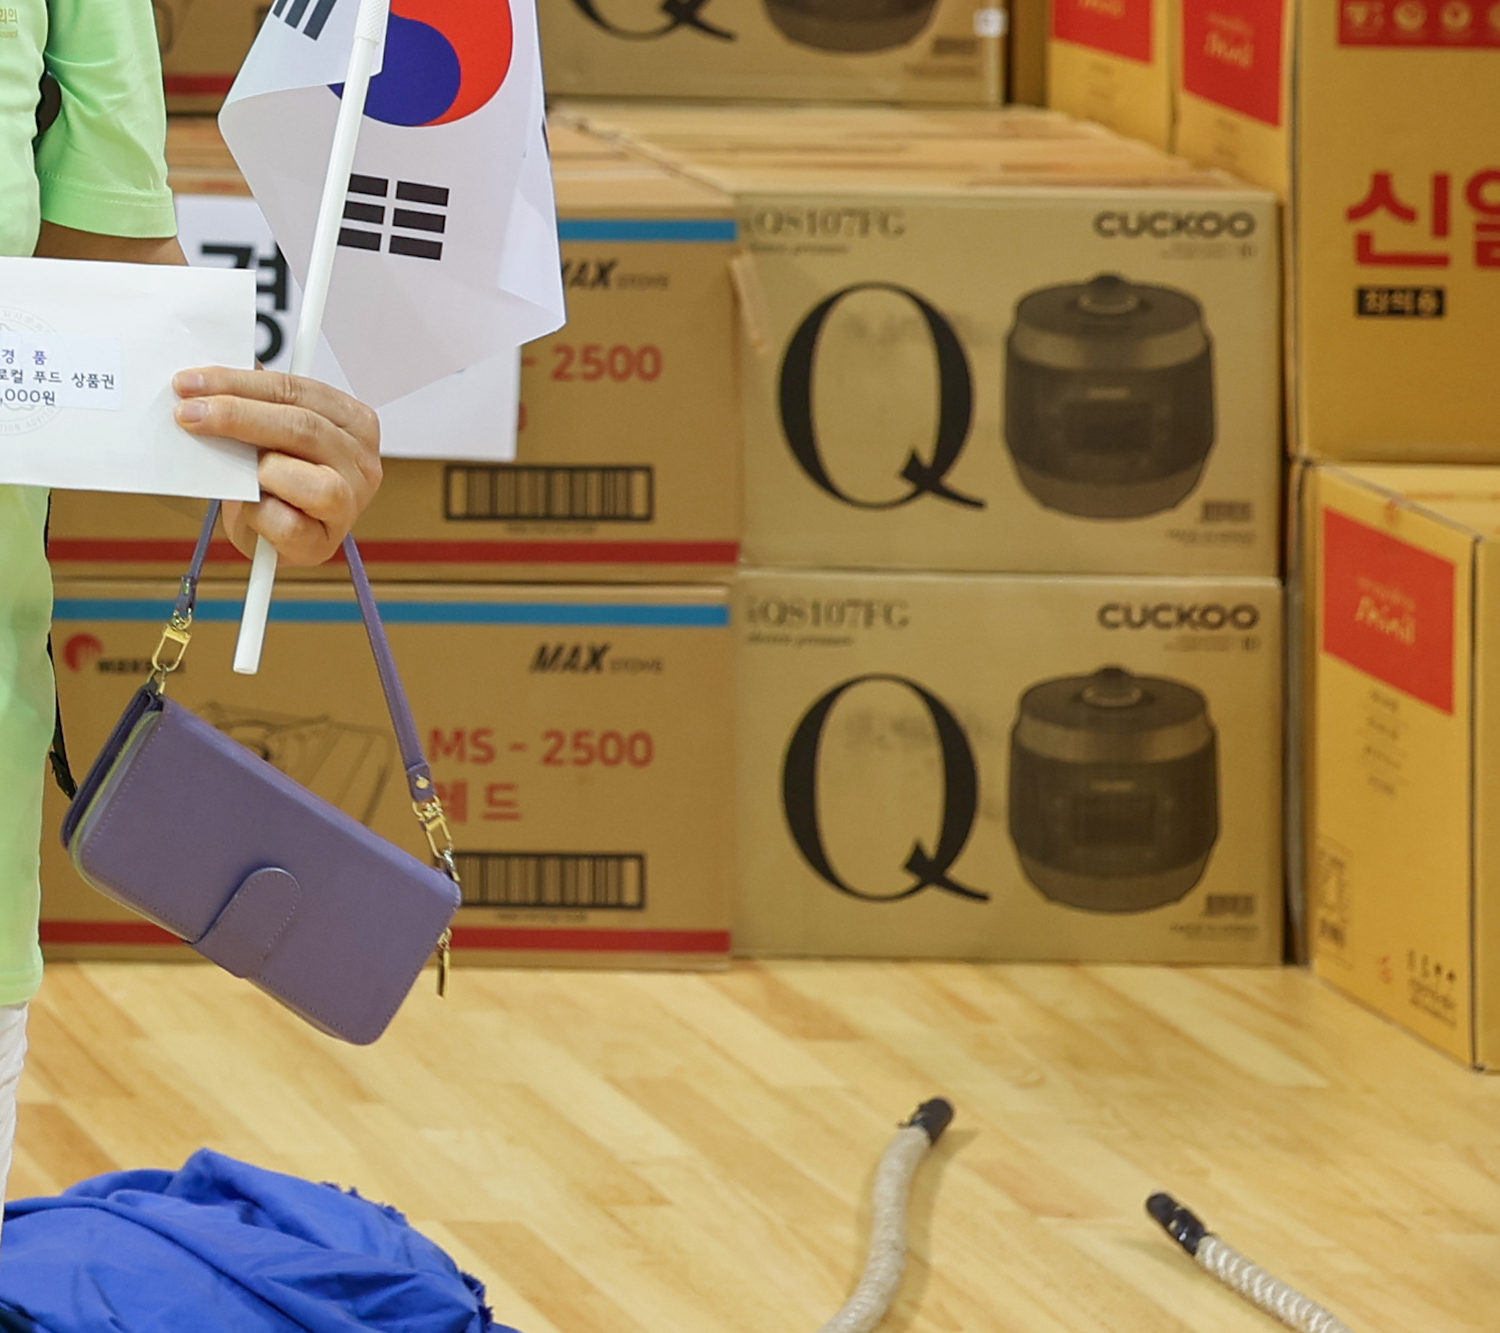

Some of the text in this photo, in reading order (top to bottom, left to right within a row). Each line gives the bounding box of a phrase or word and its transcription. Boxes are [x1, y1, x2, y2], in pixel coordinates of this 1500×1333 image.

[1092, 209, 1258, 239] CUCKOO
[33, 370, 63, 384] 푸드
[71, 373, 115, 390] 상품권
[551, 343, 664, 383] 2500
[778, 280, 988, 512] Q
[1096, 602, 1261, 631] CUCKOO
[529, 642, 611, 674] MAX
[427, 727, 496, 767] MS
[541, 728, 655, 769] 2500
[781, 672, 992, 903] Q
